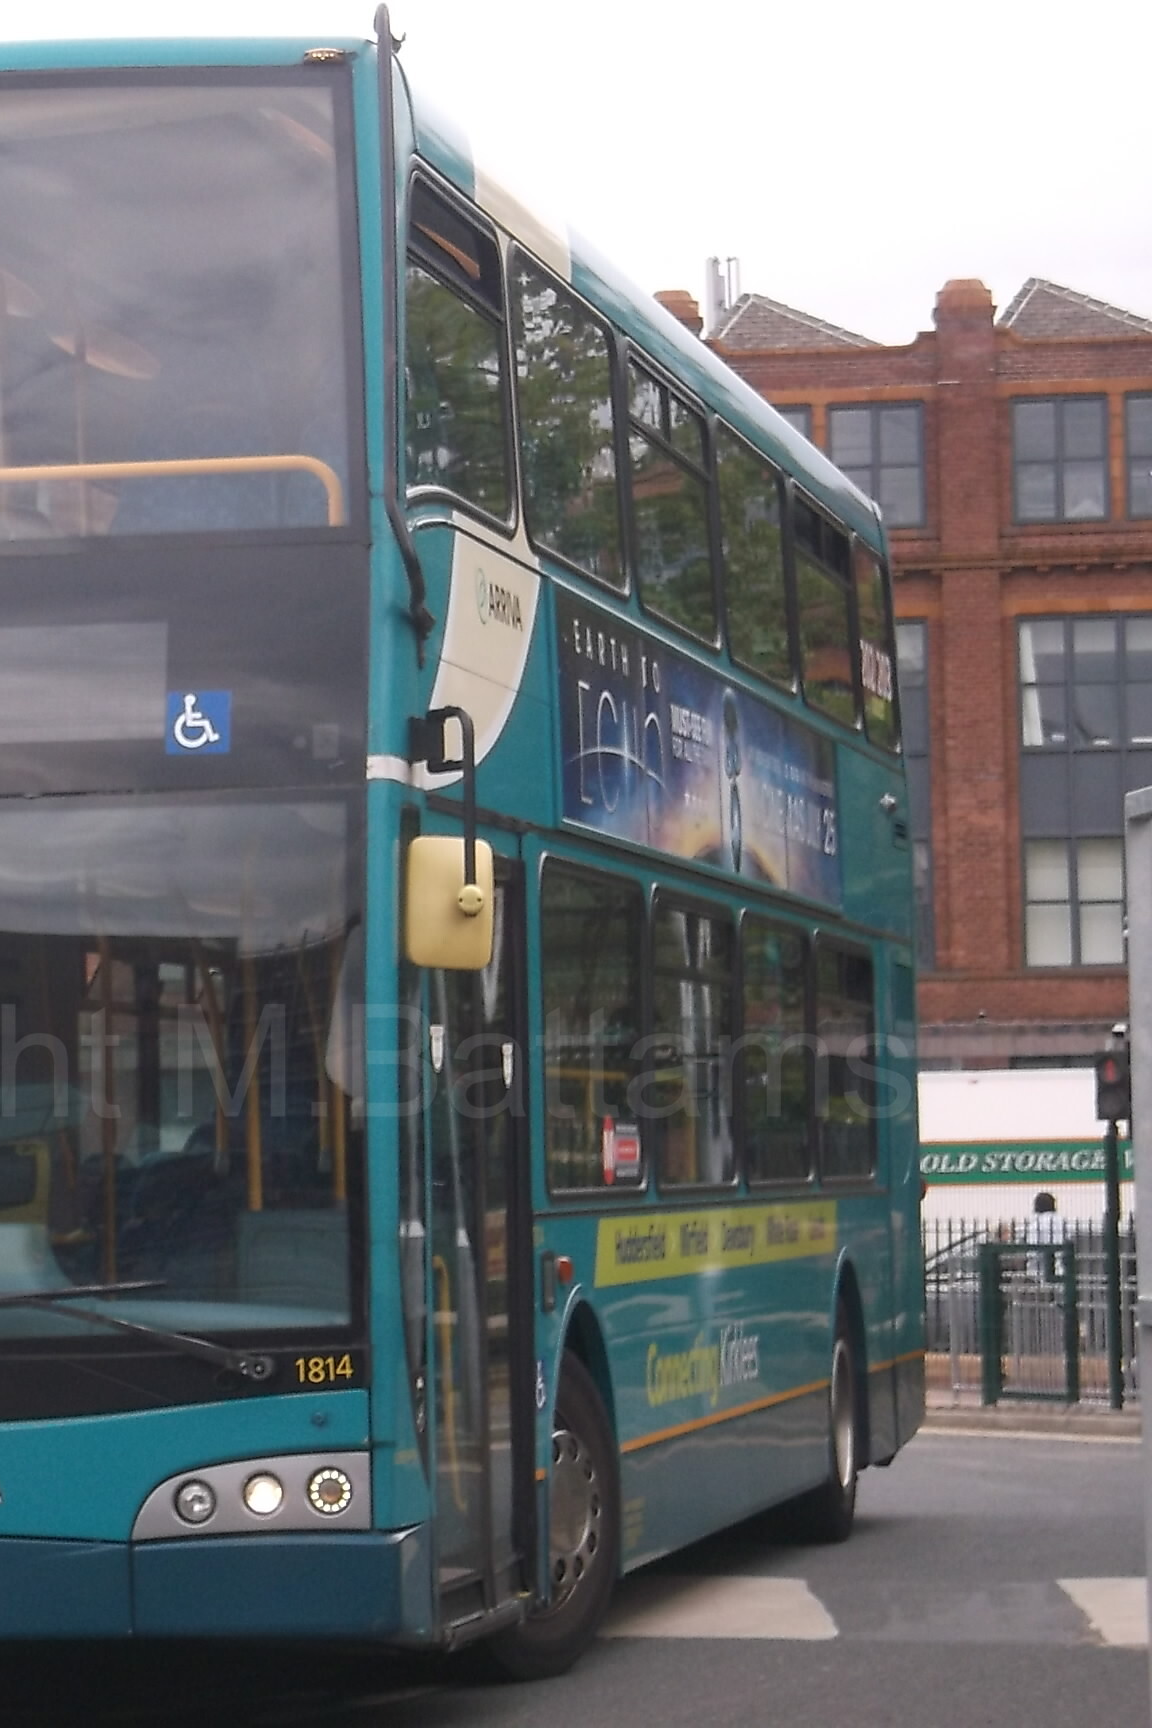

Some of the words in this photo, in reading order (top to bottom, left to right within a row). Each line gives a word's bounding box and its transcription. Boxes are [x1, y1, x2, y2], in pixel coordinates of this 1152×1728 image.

[488, 583, 523, 632] ARRIVA
[573, 619, 630, 677] EARTH
[641, 655, 661, 694] TO
[577, 680, 666, 815] ECHO
[824, 808, 836, 856] 25
[981, 1149, 1107, 1173] STORAGE
[294, 1354, 354, 1384] 1814
